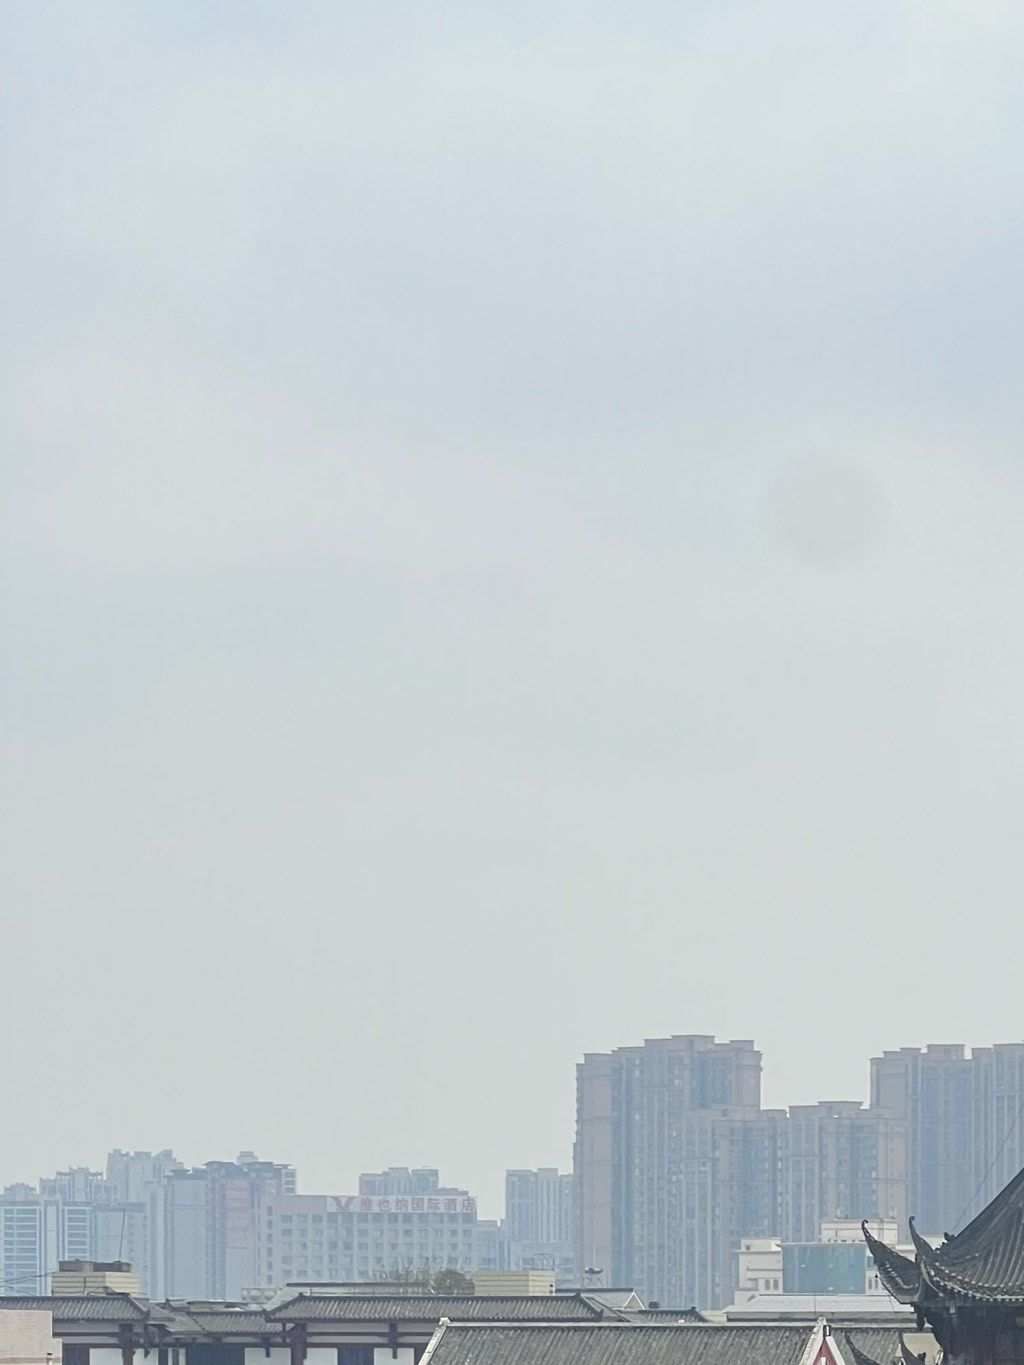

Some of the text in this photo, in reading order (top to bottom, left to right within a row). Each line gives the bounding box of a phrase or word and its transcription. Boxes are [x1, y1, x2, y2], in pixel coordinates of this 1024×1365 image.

[360, 1196, 476, 1212] 维也纳国际酒店
